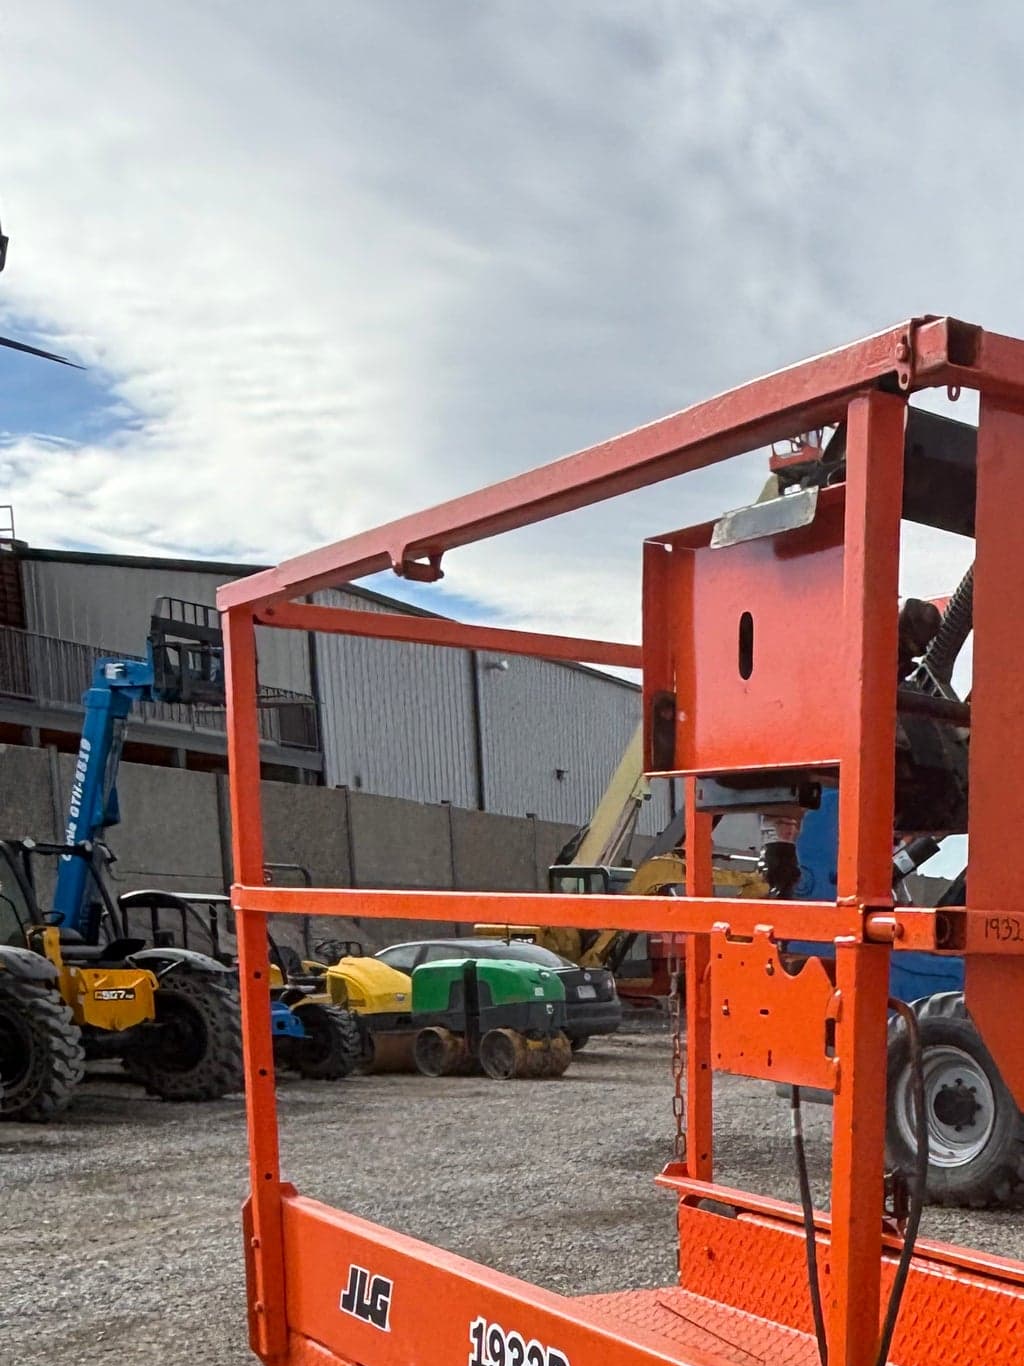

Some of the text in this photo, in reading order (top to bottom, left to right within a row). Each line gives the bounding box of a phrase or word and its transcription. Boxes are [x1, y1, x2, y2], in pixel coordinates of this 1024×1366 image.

[61, 822, 77, 861] Gnie
[985, 917, 1024, 941] 1932
[339, 1263, 394, 1333] JLG
